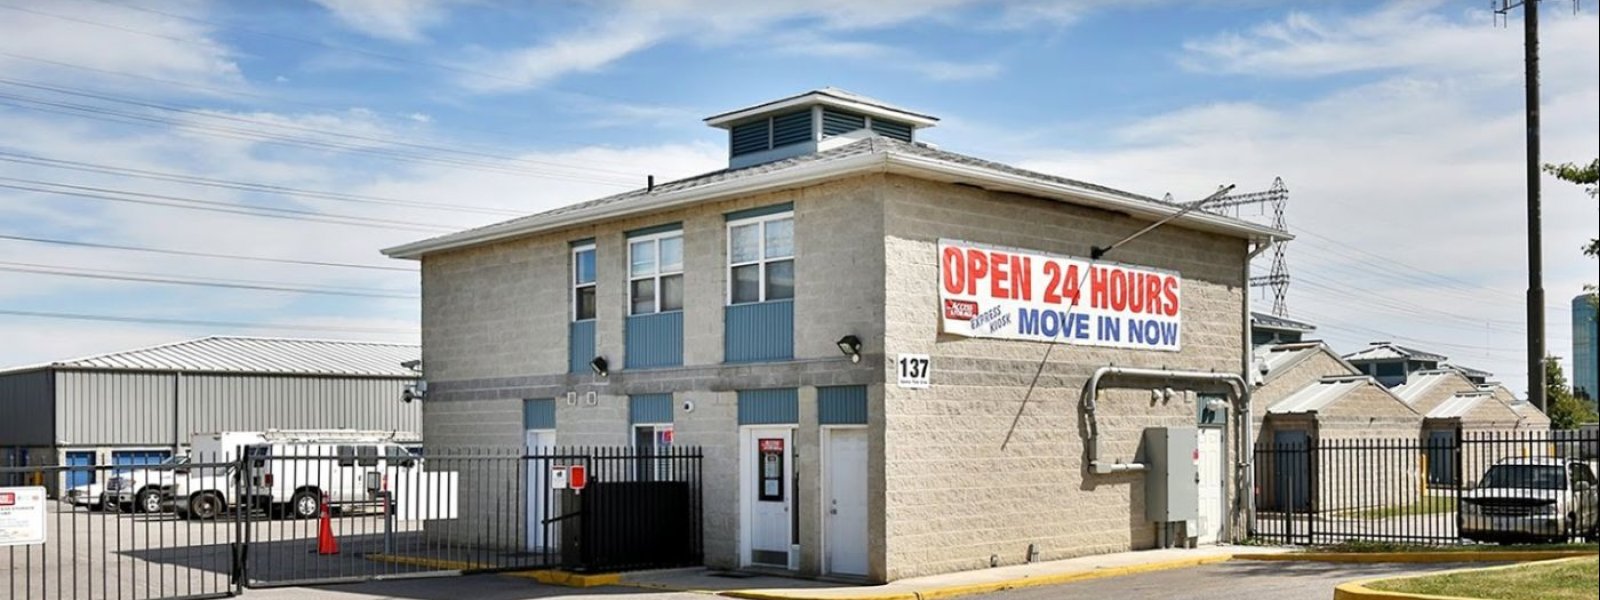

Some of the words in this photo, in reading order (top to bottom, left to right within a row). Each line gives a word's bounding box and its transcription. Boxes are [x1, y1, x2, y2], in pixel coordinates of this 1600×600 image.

[943, 246, 1031, 301] OPEN
[1043, 261, 1081, 306] 24
[1090, 266, 1179, 317] HOURS
[970, 304, 1002, 330] EXPRESS
[990, 313, 1012, 334] KIOSK
[1018, 308, 1090, 340] MOVE
[1098, 316, 1120, 342] IN
[1128, 319, 1178, 346] NOW
[900, 357, 929, 378] 137
